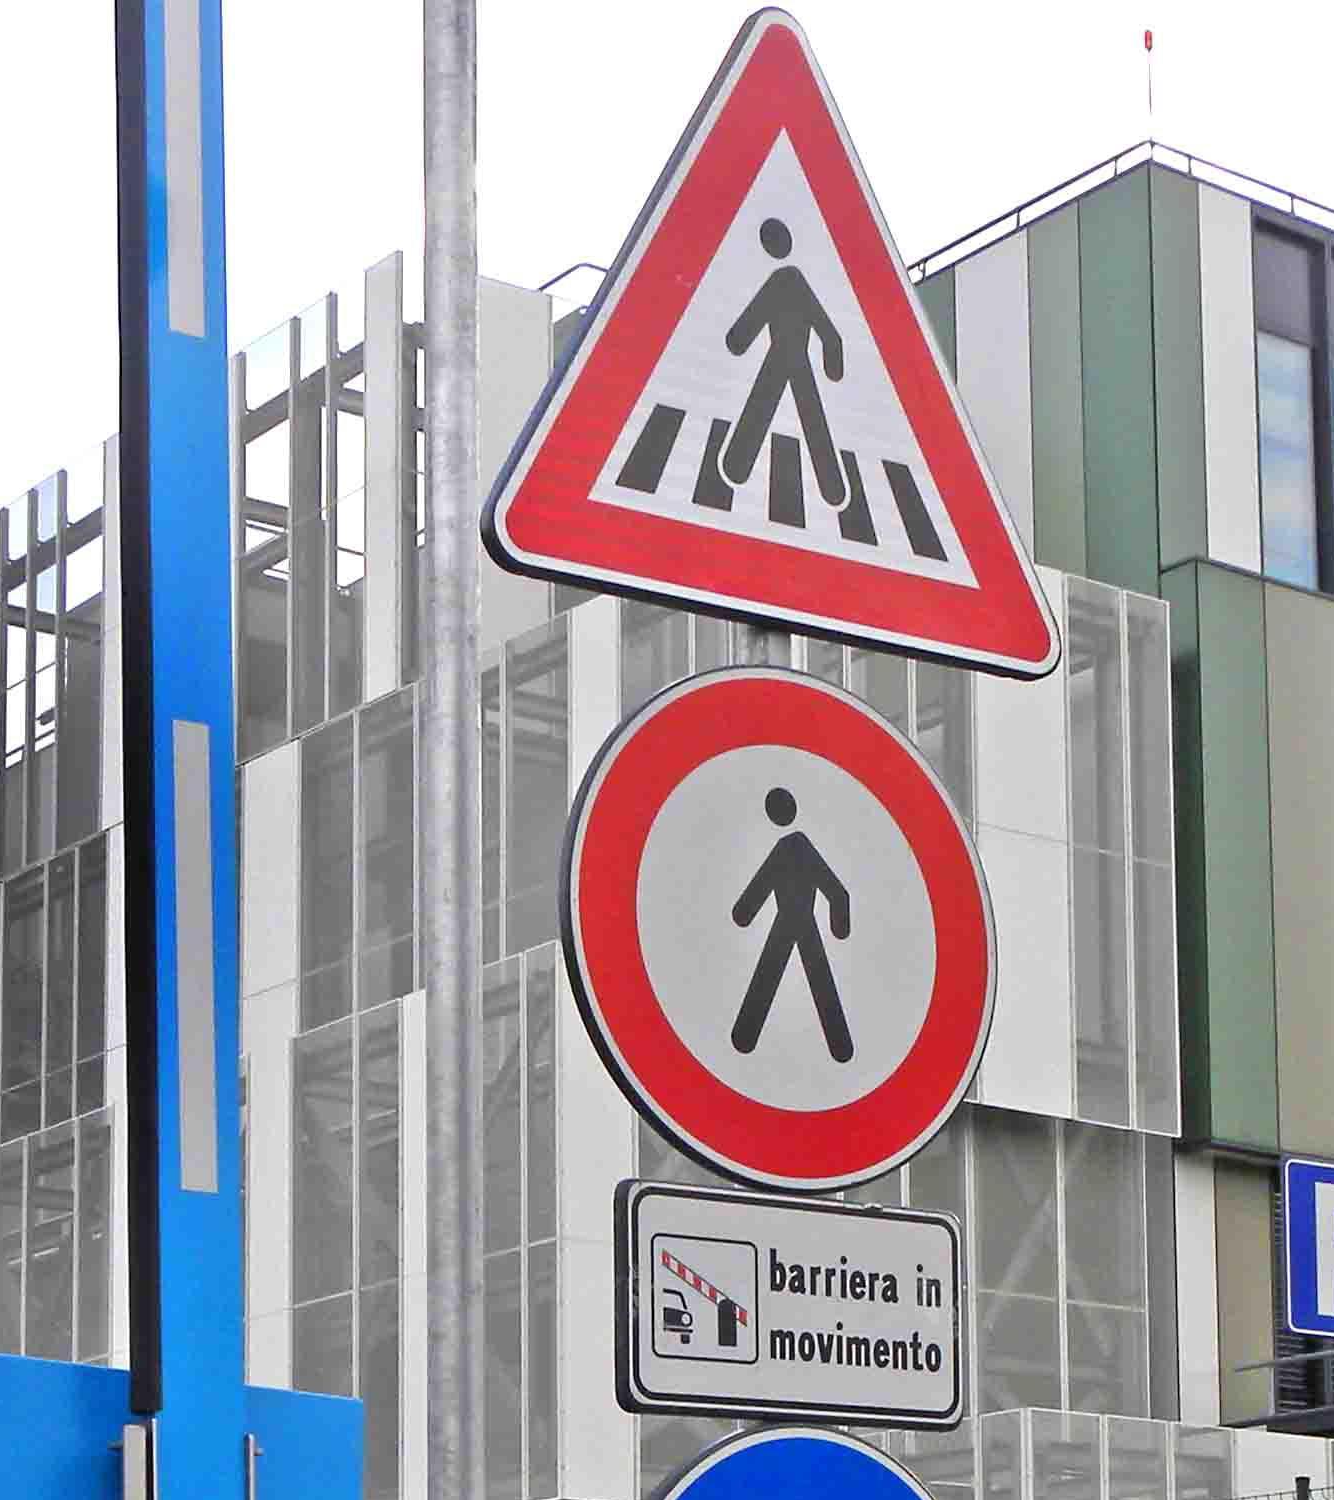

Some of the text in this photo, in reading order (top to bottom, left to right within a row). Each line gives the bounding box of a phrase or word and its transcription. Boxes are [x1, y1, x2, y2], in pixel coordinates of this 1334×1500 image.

[769, 1247, 942, 1308] barriera in
[769, 1320, 942, 1373] movimento
